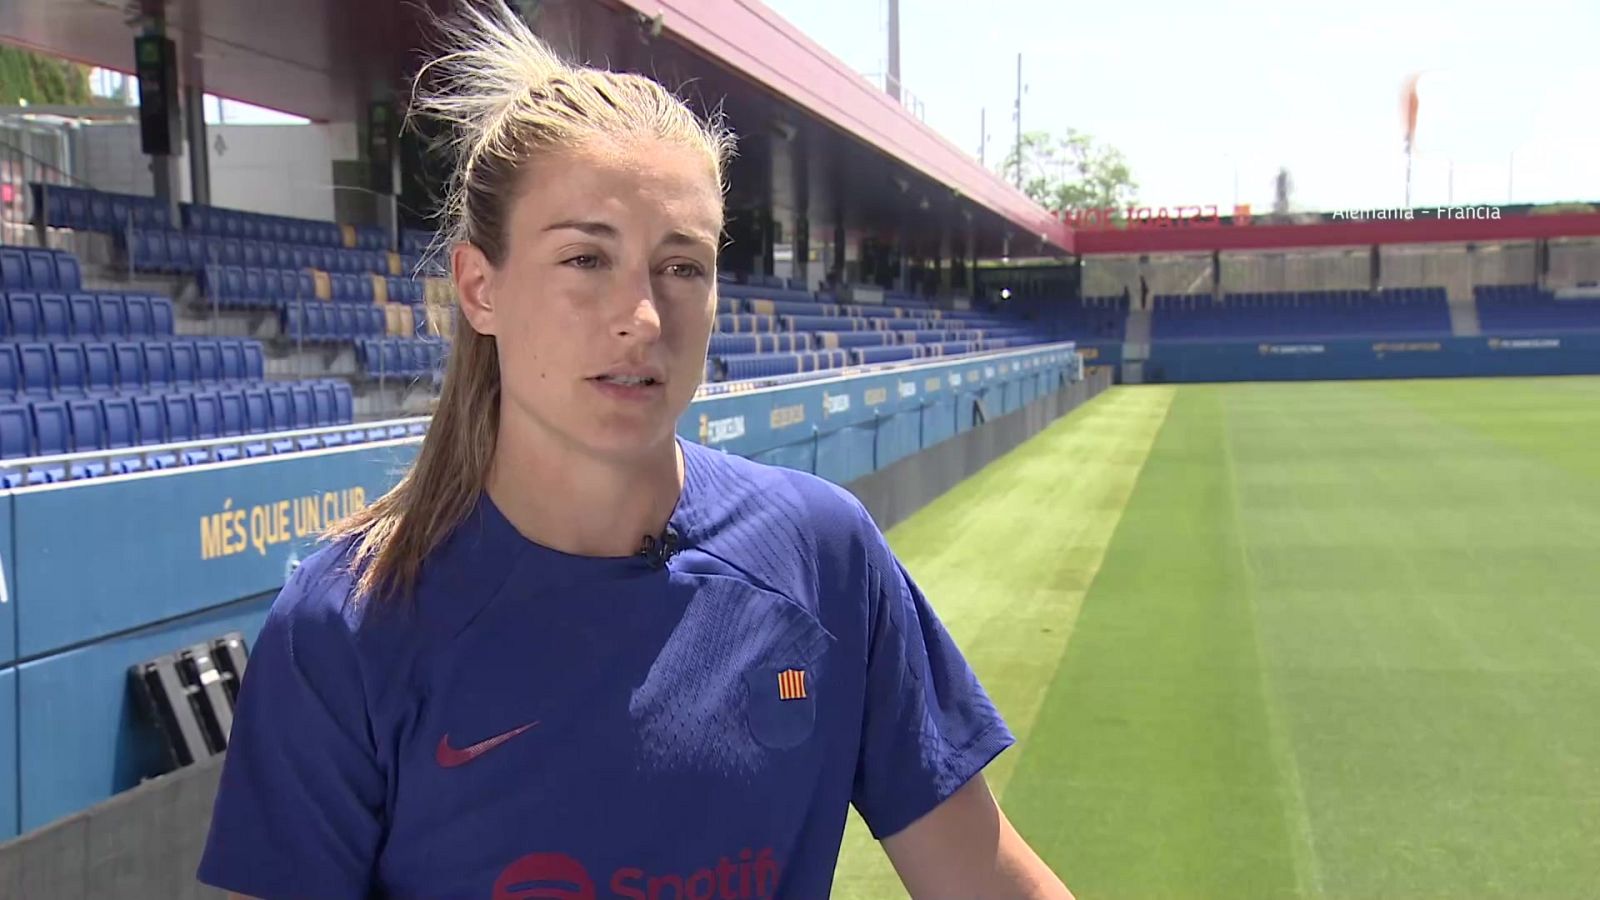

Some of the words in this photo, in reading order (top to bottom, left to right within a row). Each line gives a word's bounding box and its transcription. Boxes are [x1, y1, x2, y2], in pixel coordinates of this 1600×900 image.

[200, 497, 247, 560] MÉS
[252, 499, 291, 556] QUE
[294, 494, 320, 538] UN
